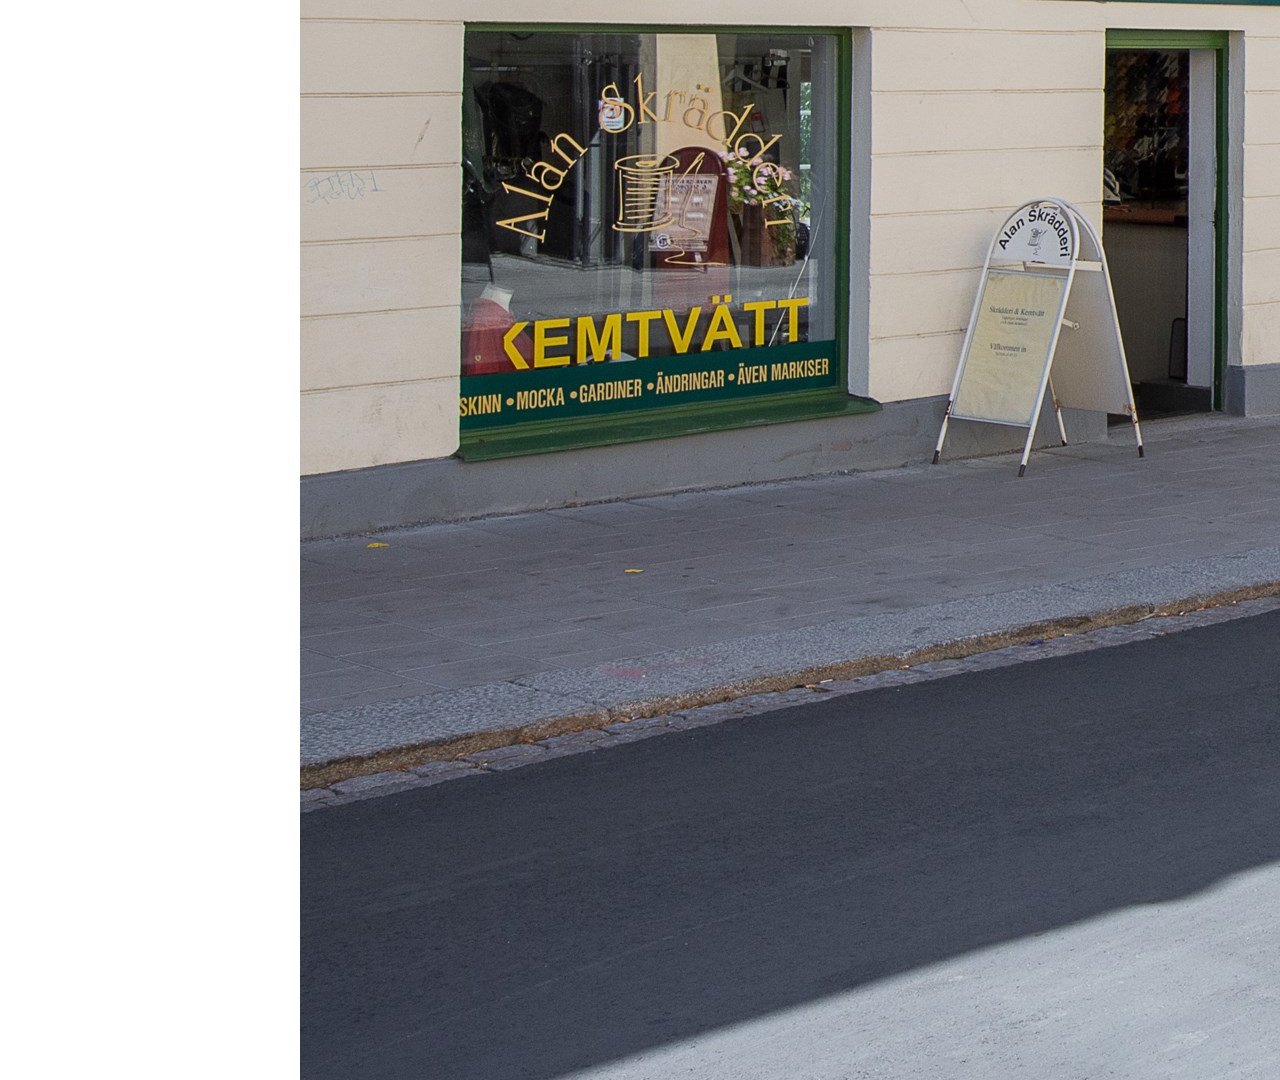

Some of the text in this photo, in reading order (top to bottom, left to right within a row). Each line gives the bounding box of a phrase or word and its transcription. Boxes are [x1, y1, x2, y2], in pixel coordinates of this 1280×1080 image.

[496, 72, 794, 244] Alan Skrädderi
[999, 208, 1070, 257] Alan Skrädderi
[460, 358, 829, 417] SKINN MOCKA GARDINER ÄNDRINGAR ÄVEN MARKISER
